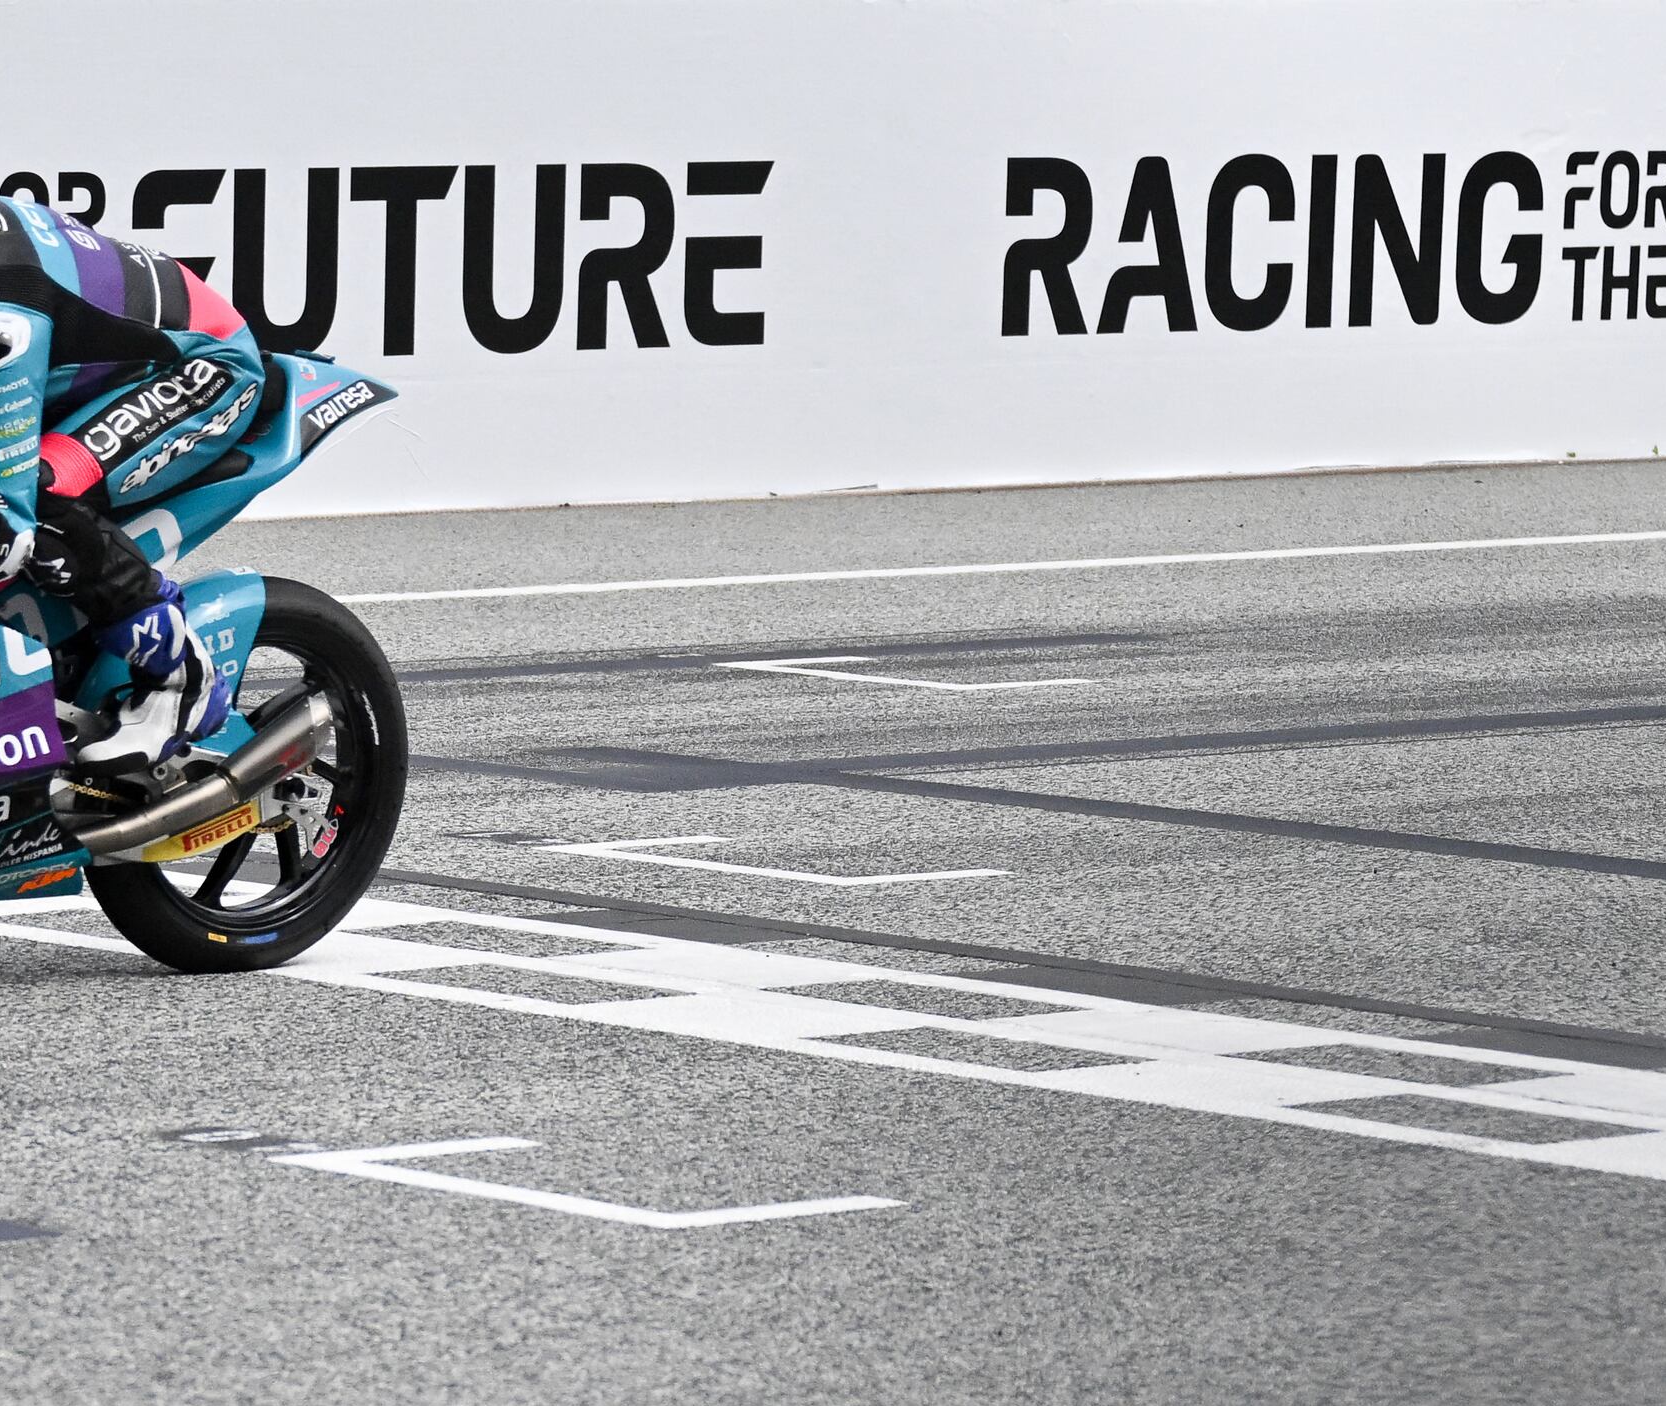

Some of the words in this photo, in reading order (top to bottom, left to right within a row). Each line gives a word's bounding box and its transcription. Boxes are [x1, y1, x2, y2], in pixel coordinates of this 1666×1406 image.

[1001, 150, 1544, 337] RACING
[84, 358, 218, 461] gaviota
[132, 432, 148, 444] The
[184, 805, 255, 852] PIRELLI
[22, 843, 64, 862] HISPANIA
